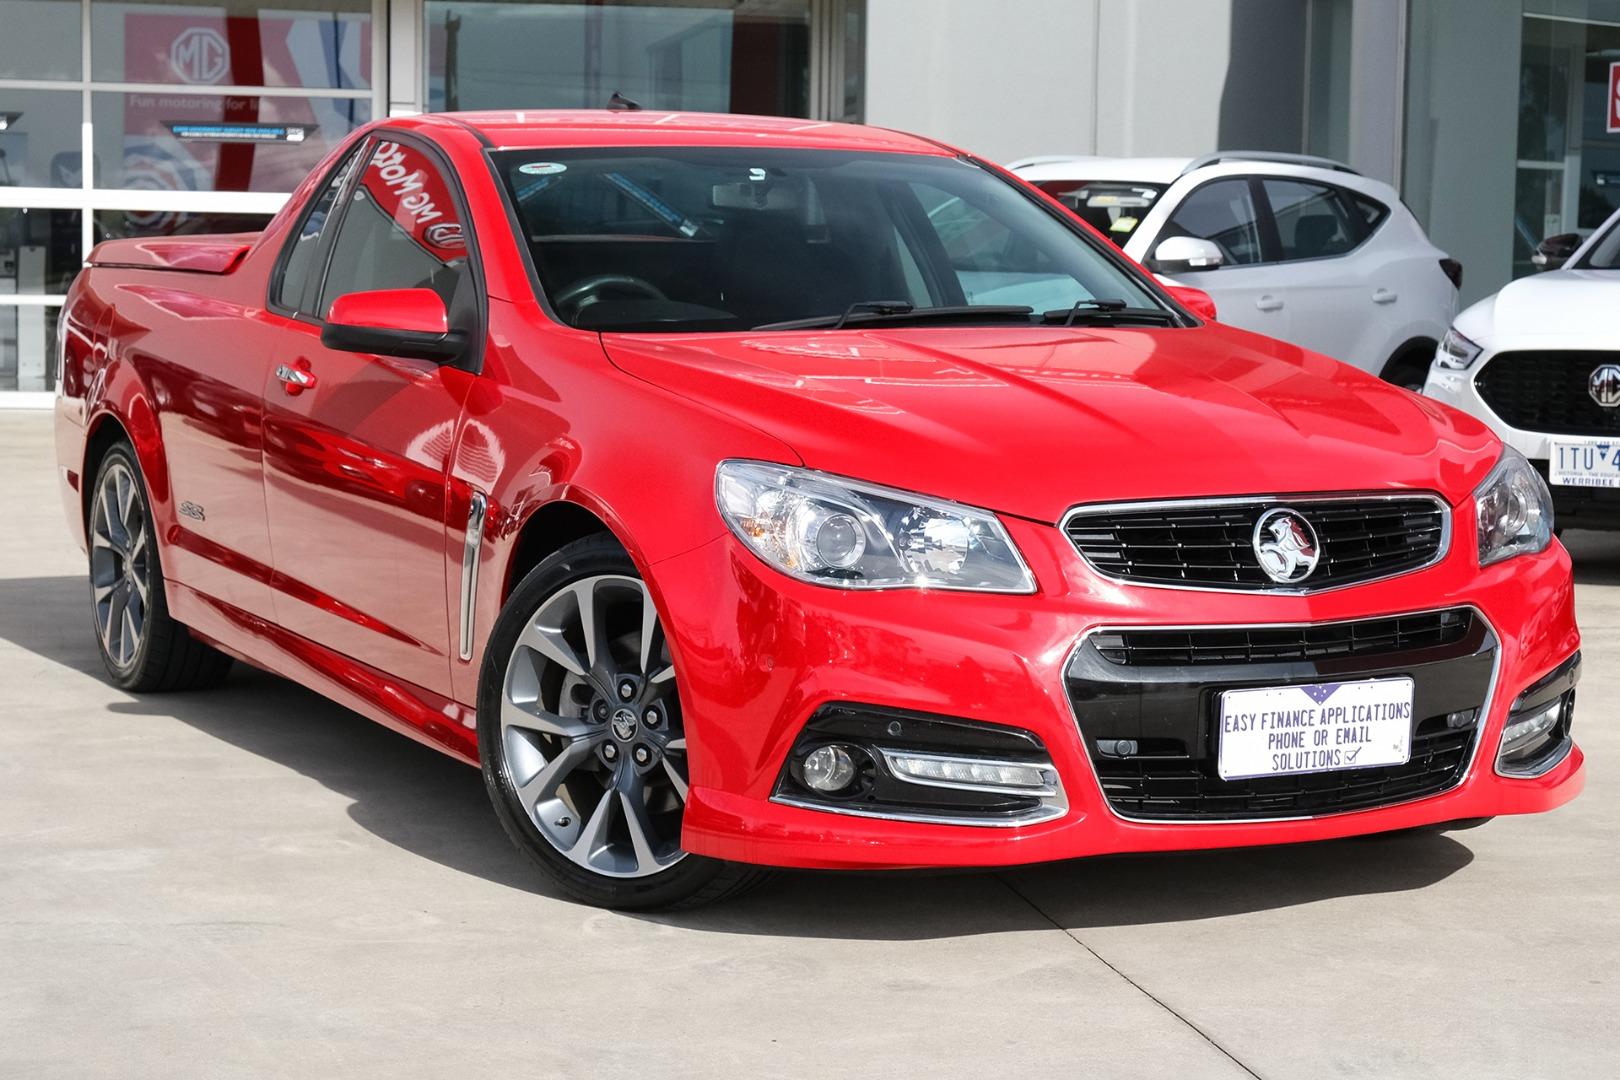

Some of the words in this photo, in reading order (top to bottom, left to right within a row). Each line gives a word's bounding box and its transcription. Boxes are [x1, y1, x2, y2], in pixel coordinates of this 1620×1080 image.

[176, 33, 225, 80] MG
[1563, 477, 1614, 487] WERRIBEE
[1225, 713, 1256, 733] EASY
[1261, 709, 1316, 730] FINANCE
[1320, 702, 1411, 725] APPLICATIONS
[1268, 731, 1306, 750] PHONE
[1314, 729, 1329, 746] OR
[1336, 726, 1372, 745] EMAIL
[1272, 749, 1341, 771] SOLUTIONS
